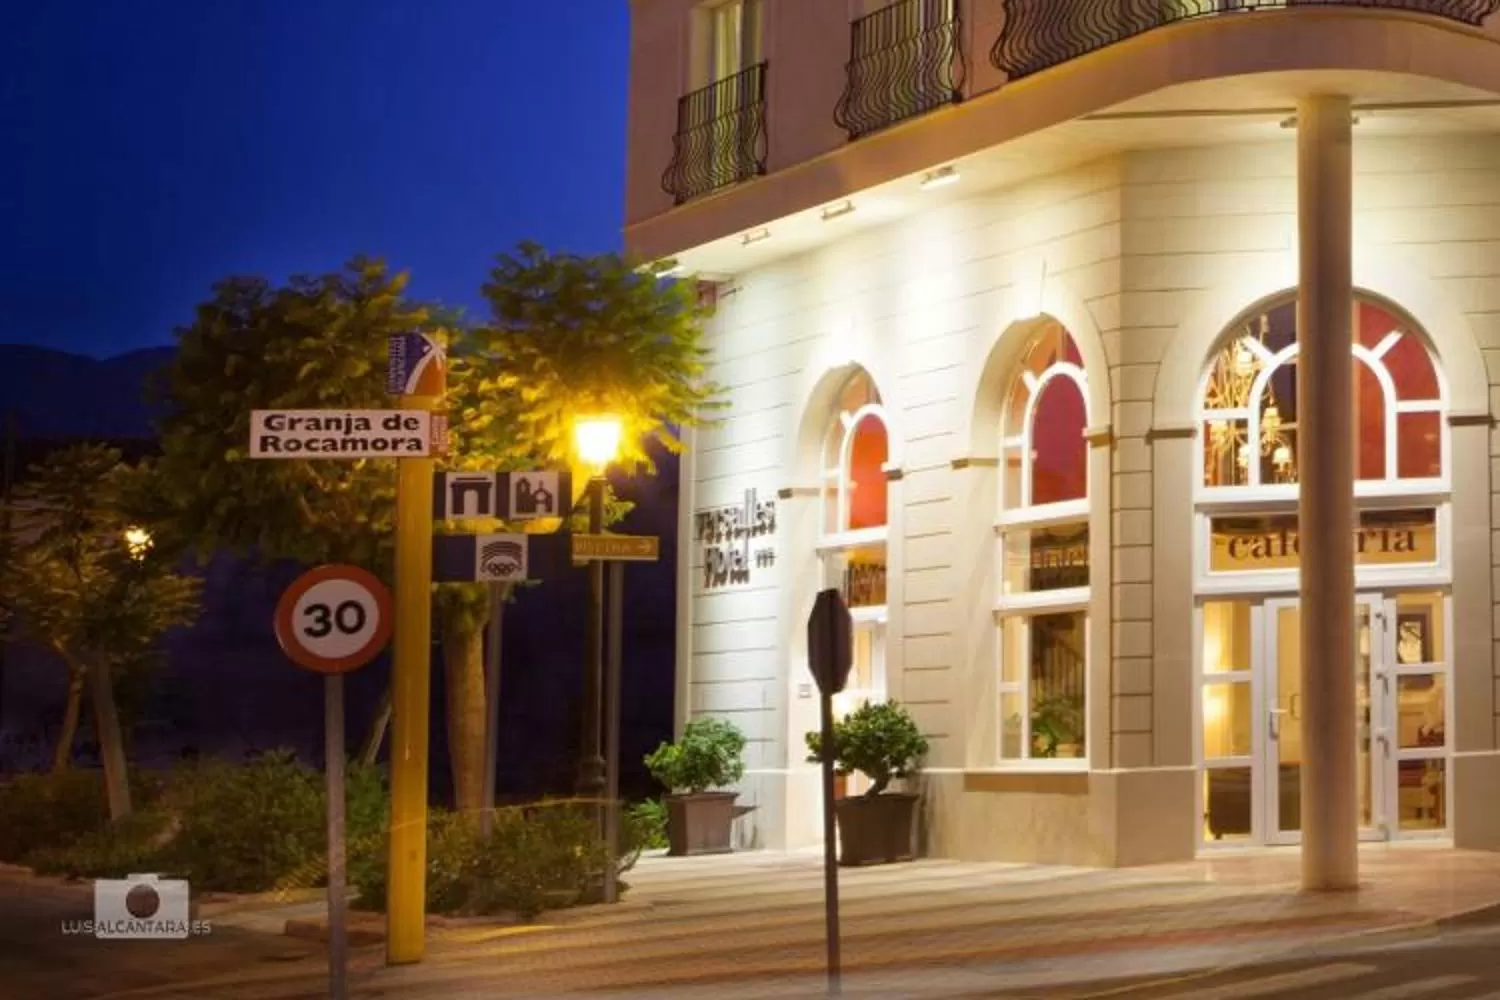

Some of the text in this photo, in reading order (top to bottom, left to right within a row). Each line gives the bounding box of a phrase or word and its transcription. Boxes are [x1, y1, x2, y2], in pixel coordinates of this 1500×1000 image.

[263, 413, 420, 435] Granja de
[259, 435, 422, 453] Rocamora
[303, 600, 366, 638] 30
